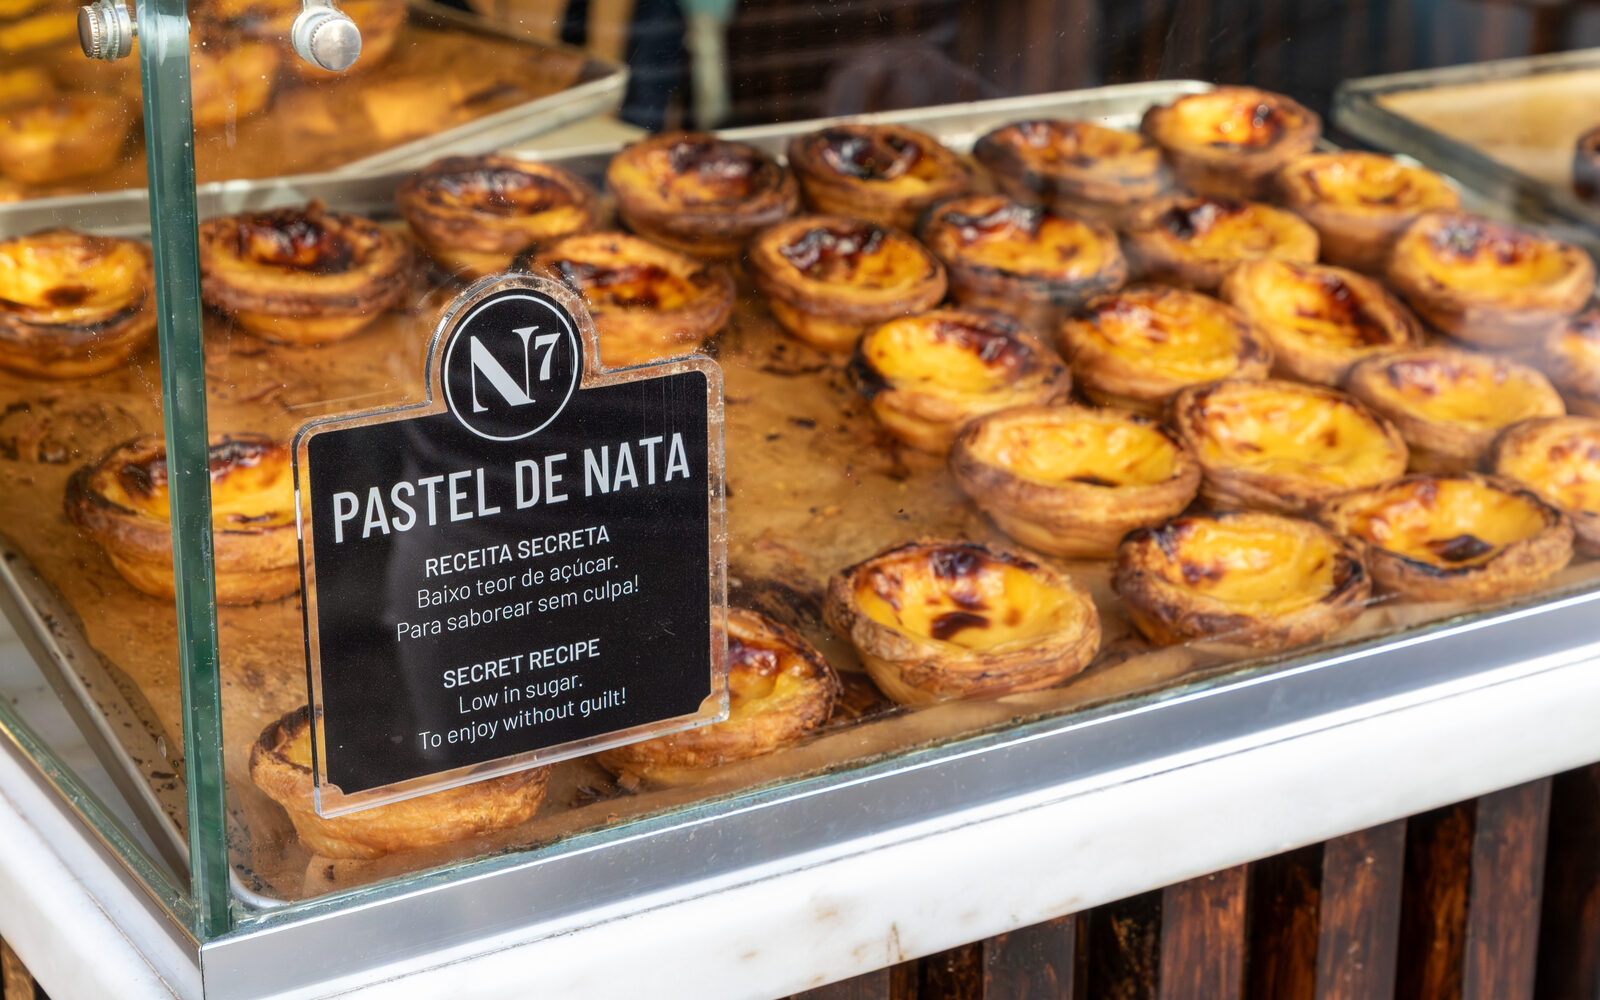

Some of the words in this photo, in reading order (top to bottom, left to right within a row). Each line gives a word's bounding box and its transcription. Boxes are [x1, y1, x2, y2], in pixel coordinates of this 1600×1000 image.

[470, 325, 561, 413] N7
[333, 467, 501, 544] PASTEL
[514, 452, 569, 510] DE
[583, 432, 691, 497] NATA
[425, 543, 513, 578] RECEITA
[517, 525, 610, 559] SECRETA
[397, 619, 442, 642] Para
[447, 600, 533, 632] saborear
[537, 590, 578, 612] sem
[583, 574, 639, 603] culpa!
[417, 583, 471, 609] Baixo
[476, 574, 516, 596] teor
[521, 567, 544, 588] de
[549, 554, 619, 583] açúcar.
[443, 654, 524, 689] SECRET
[529, 638, 601, 671] RECIPE
[418, 730, 442, 750] To
[447, 720, 499, 744] enjoy
[502, 700, 575, 731] without
[580, 686, 626, 718] guilt!
[459, 691, 498, 714] Low
[503, 685, 521, 704] in
[525, 673, 583, 698] sugar.
